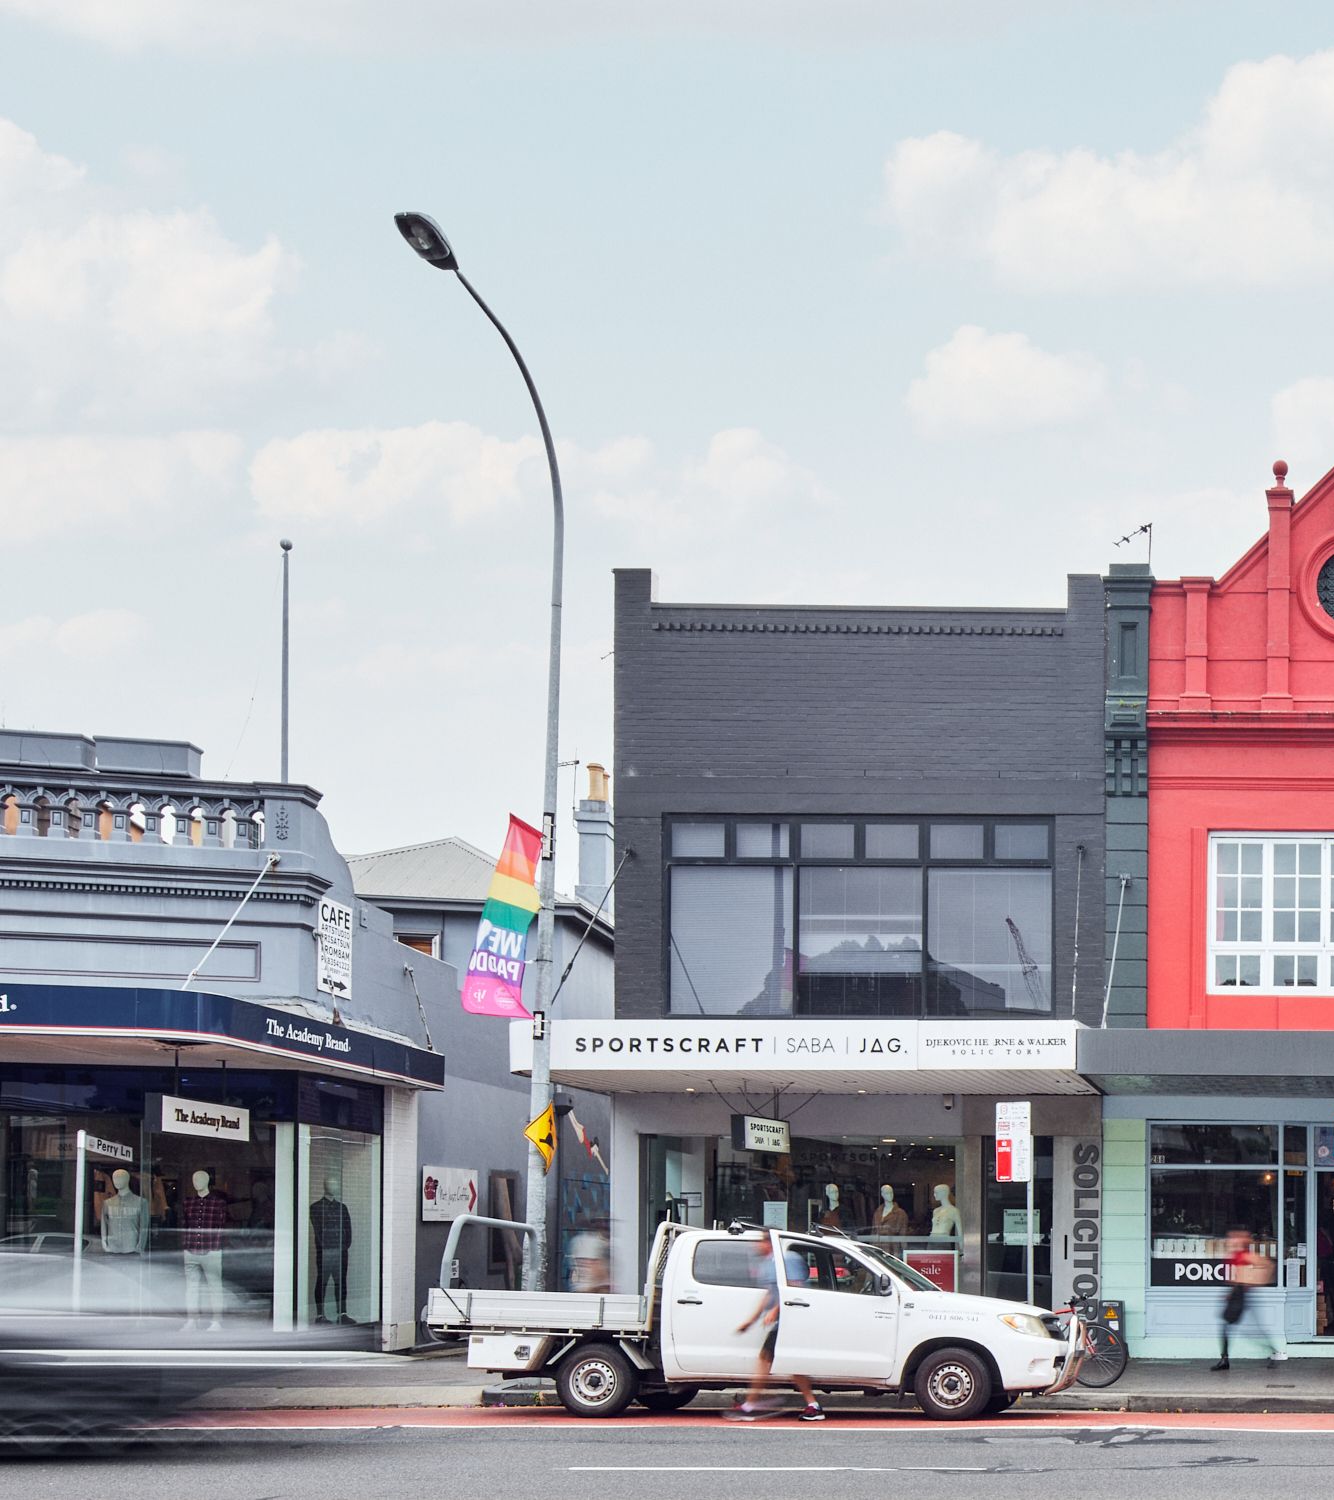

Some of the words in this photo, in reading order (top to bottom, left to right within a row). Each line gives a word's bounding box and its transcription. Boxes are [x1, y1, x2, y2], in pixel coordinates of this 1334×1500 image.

[321, 903, 350, 930] CAFE
[321, 933, 350, 949] RISATSUN
[321, 944, 350, 961] ROM8AM
[266, 1018, 284, 1037] The
[286, 1023, 324, 1051] Academy
[925, 1038, 973, 1048] DJEKOVIC
[1017, 1038, 1025, 1046] &
[1027, 1037, 1067, 1047] WALKER
[575, 1037, 763, 1053] SPORTSCRAFT
[786, 1037, 836, 1053] SABA
[175, 1108, 188, 1123] The
[190, 1110, 220, 1131] Academy
[221, 1117, 240, 1130] Brand
[750, 1122, 785, 1135] SPORTSCRAFT
[97, 1139, 119, 1157] Perry
[121, 1148, 131, 1158] Ln
[921, 1264, 941, 1275] sale
